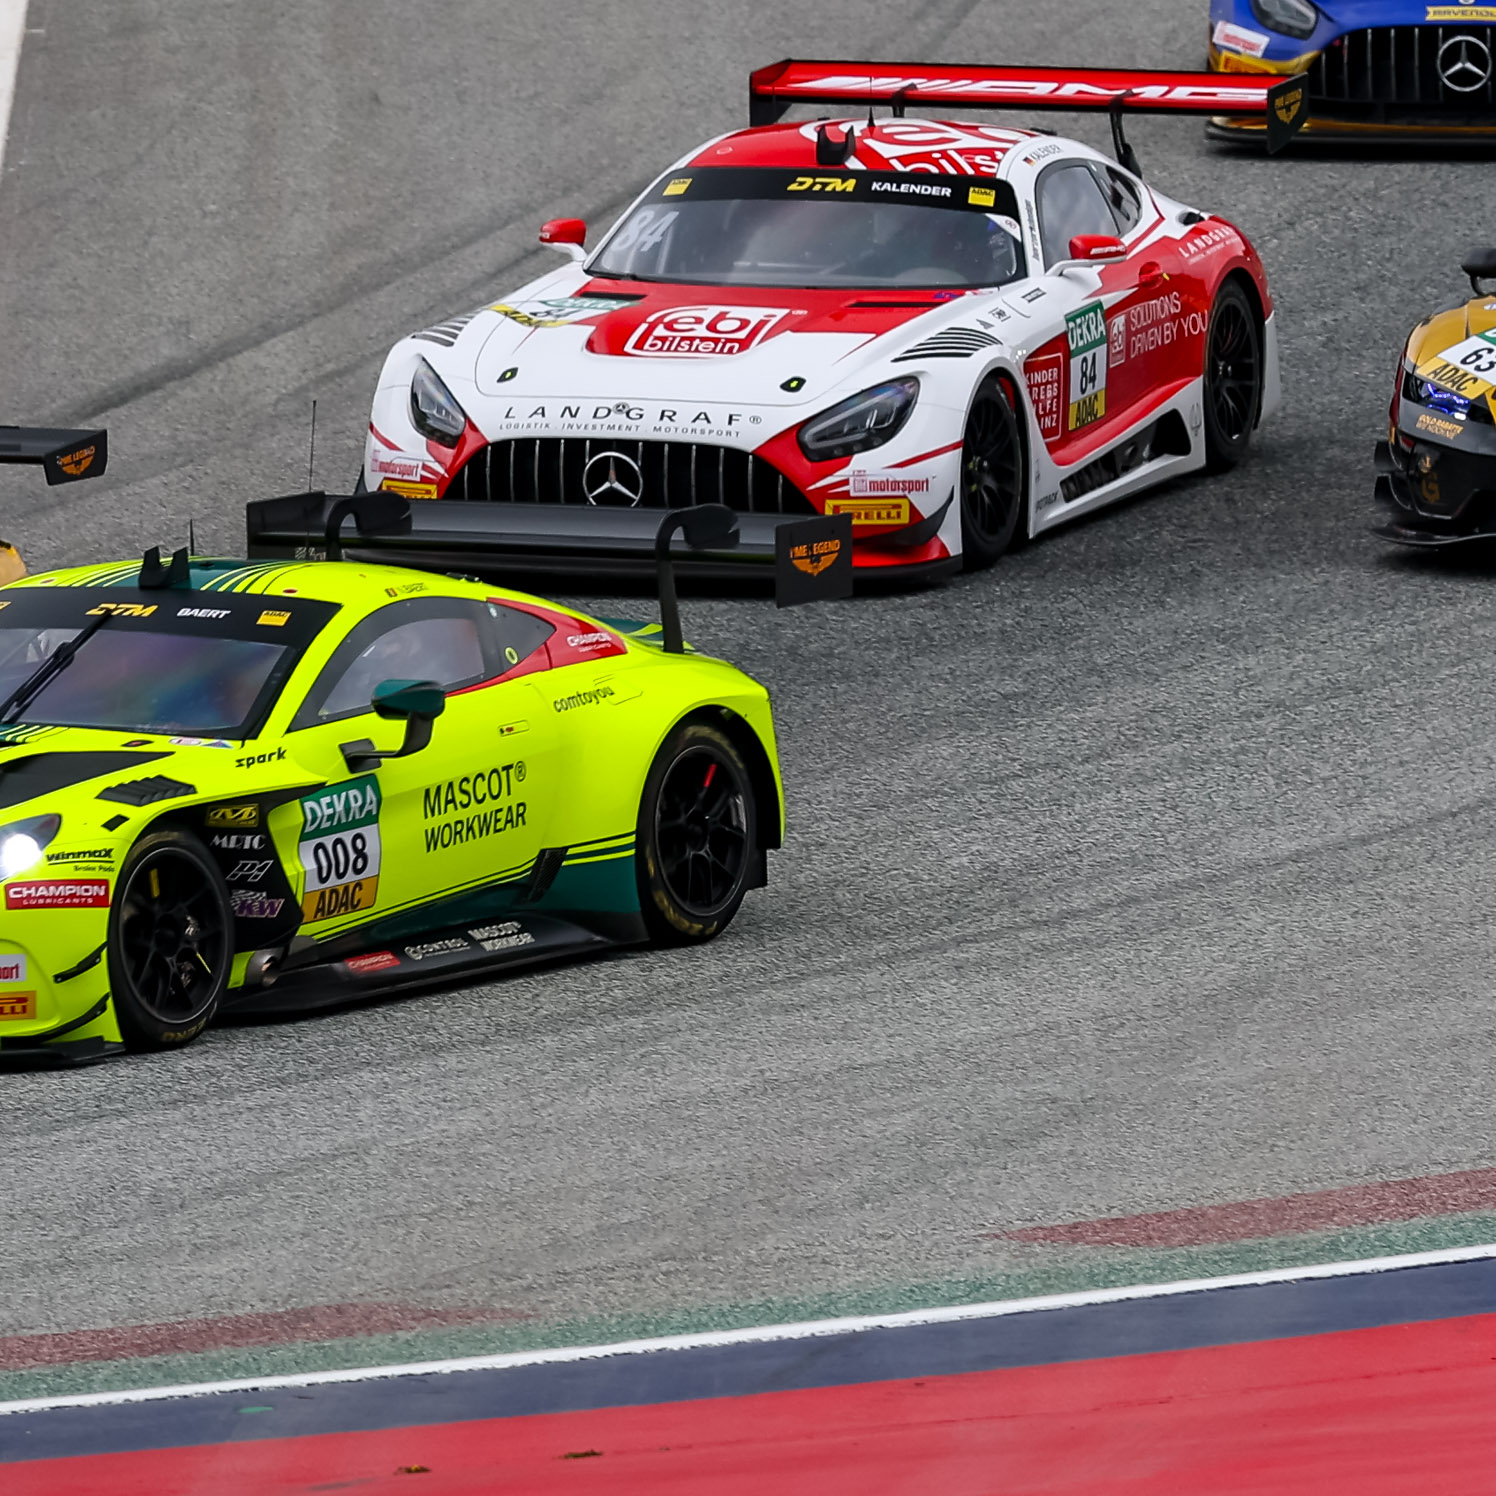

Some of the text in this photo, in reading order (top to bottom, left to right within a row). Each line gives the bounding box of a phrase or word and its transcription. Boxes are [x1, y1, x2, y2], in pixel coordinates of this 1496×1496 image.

[960, 80, 1269, 101] AMG
[787, 177, 856, 192] DTM
[871, 180, 951, 197] KALENDER
[616, 210, 679, 253] 84
[1130, 292, 1182, 327] SOLUTIONS
[1068, 307, 1106, 349] DEKRA
[1130, 310, 1208, 358] DRIVEN BY YOU
[644, 337, 740, 354] bilstein
[1079, 353, 1097, 395] 84
[1430, 364, 1478, 392] ADAC
[505, 405, 742, 426] LANDGRAF
[1074, 394, 1099, 428] ADAC
[500, 422, 740, 437] LOGISTIK INVESTMENT MOTORSPORT
[869, 477, 929, 492] motorsport
[86, 603, 159, 617] DTM
[176, 607, 231, 619] BAERT
[567, 633, 612, 647] CHAMPION
[553, 685, 615, 712] comtoyou
[235, 747, 287, 769] spark
[304, 784, 378, 833] DEKRA
[425, 802, 527, 853] WORKWEAR
[313, 831, 369, 886] 008
[9, 885, 105, 898] CHAMPION
[22, 897, 94, 905] LUBRICANTS
[313, 881, 363, 920] ADAC
